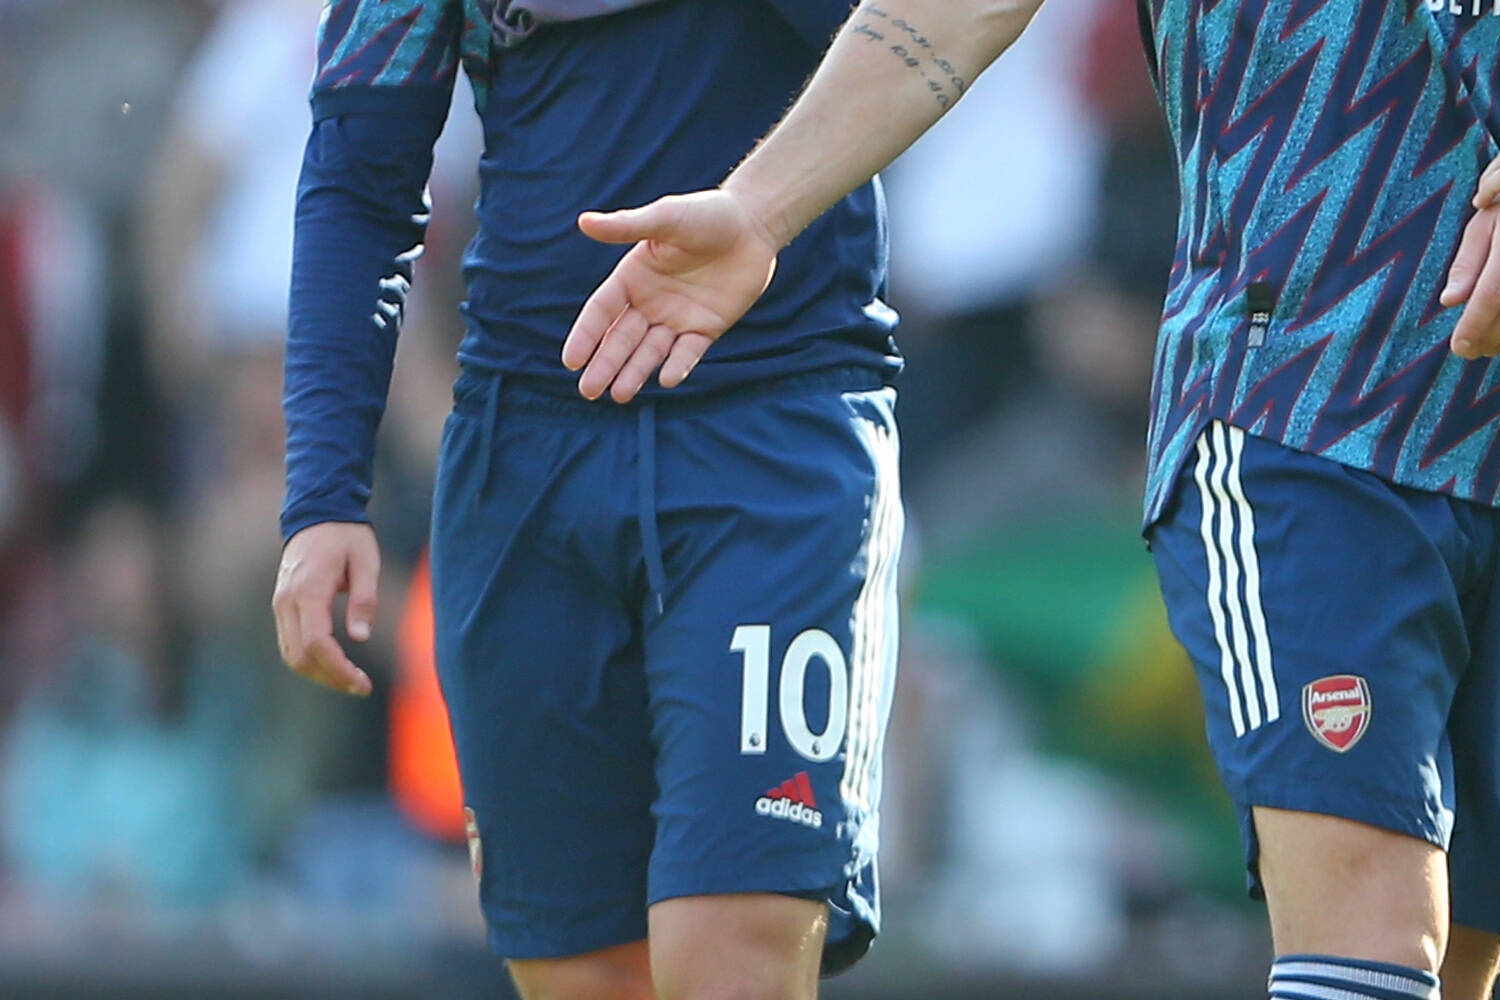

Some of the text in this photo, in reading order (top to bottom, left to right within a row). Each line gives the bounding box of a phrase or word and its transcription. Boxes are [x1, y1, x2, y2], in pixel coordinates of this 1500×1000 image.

[729, 624, 849, 763] 10
[1311, 685, 1361, 705] Arsenal
[755, 796, 823, 829] adidas
